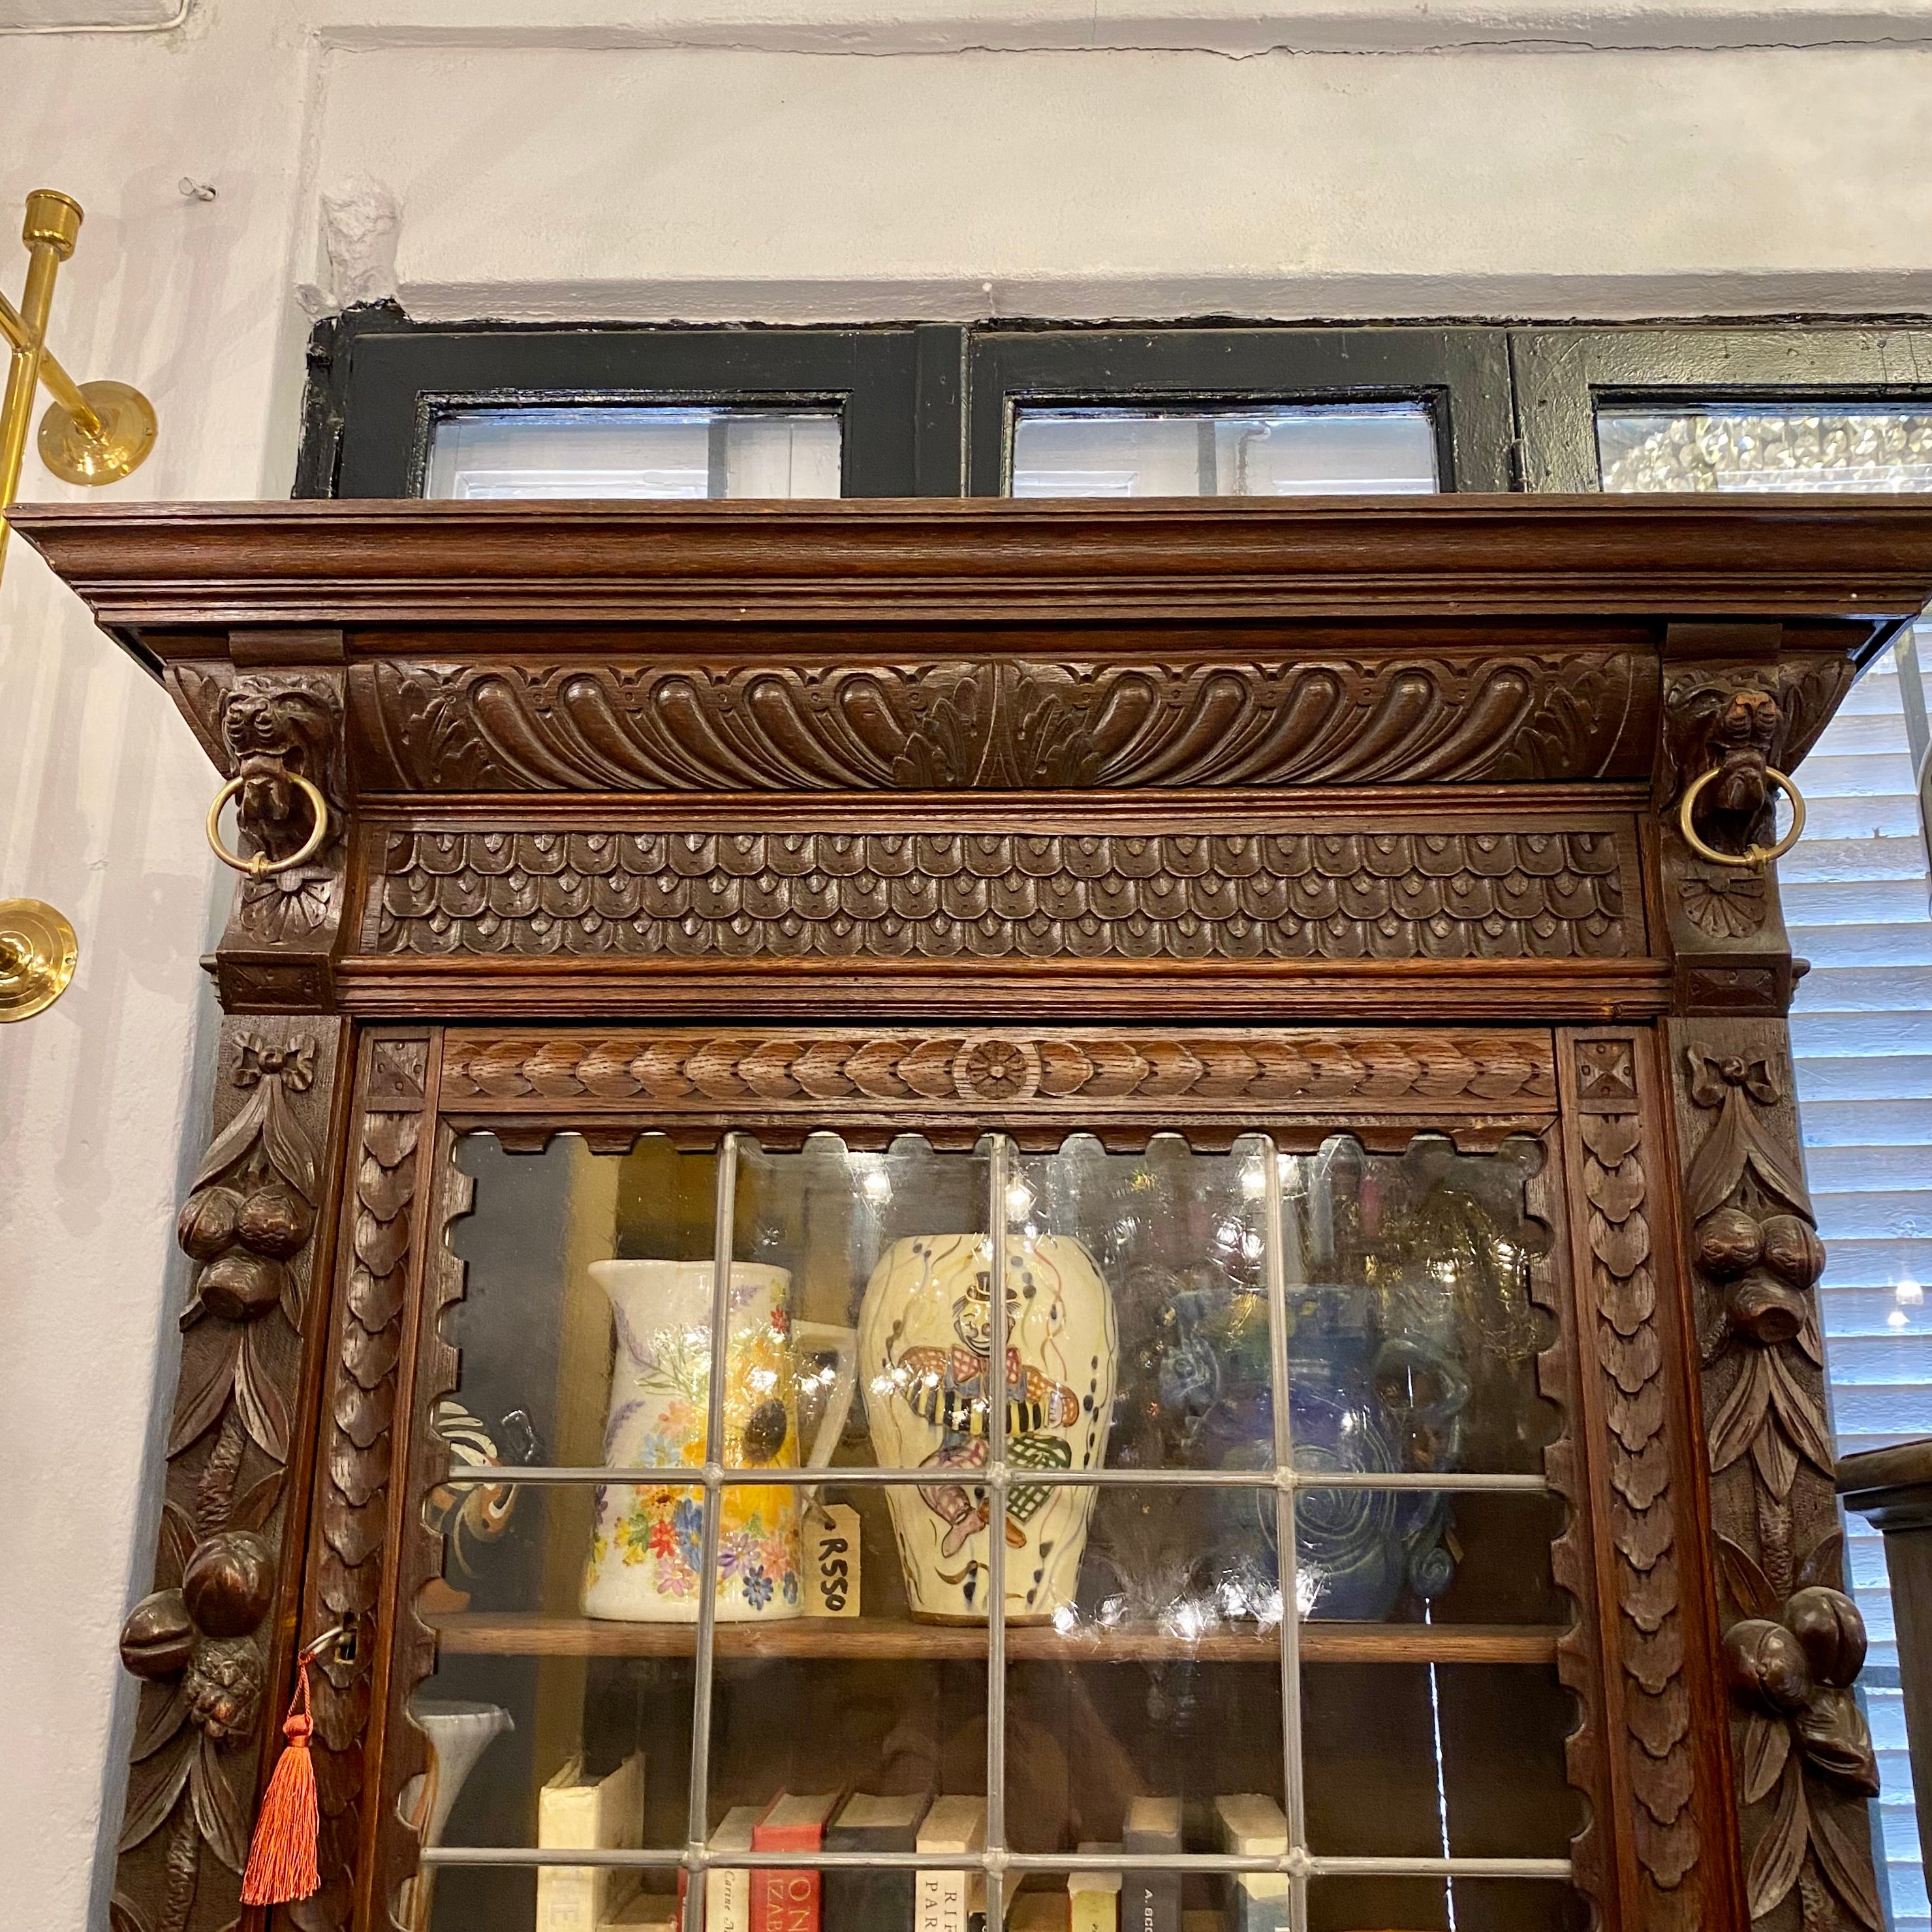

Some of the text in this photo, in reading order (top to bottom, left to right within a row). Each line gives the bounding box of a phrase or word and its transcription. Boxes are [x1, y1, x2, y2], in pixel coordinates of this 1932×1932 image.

[723, 1871, 736, 1910] Carine
[788, 1877, 811, 1932] ON
[925, 1880, 938, 1929] PAR
[1145, 1889, 1153, 1903] A.
